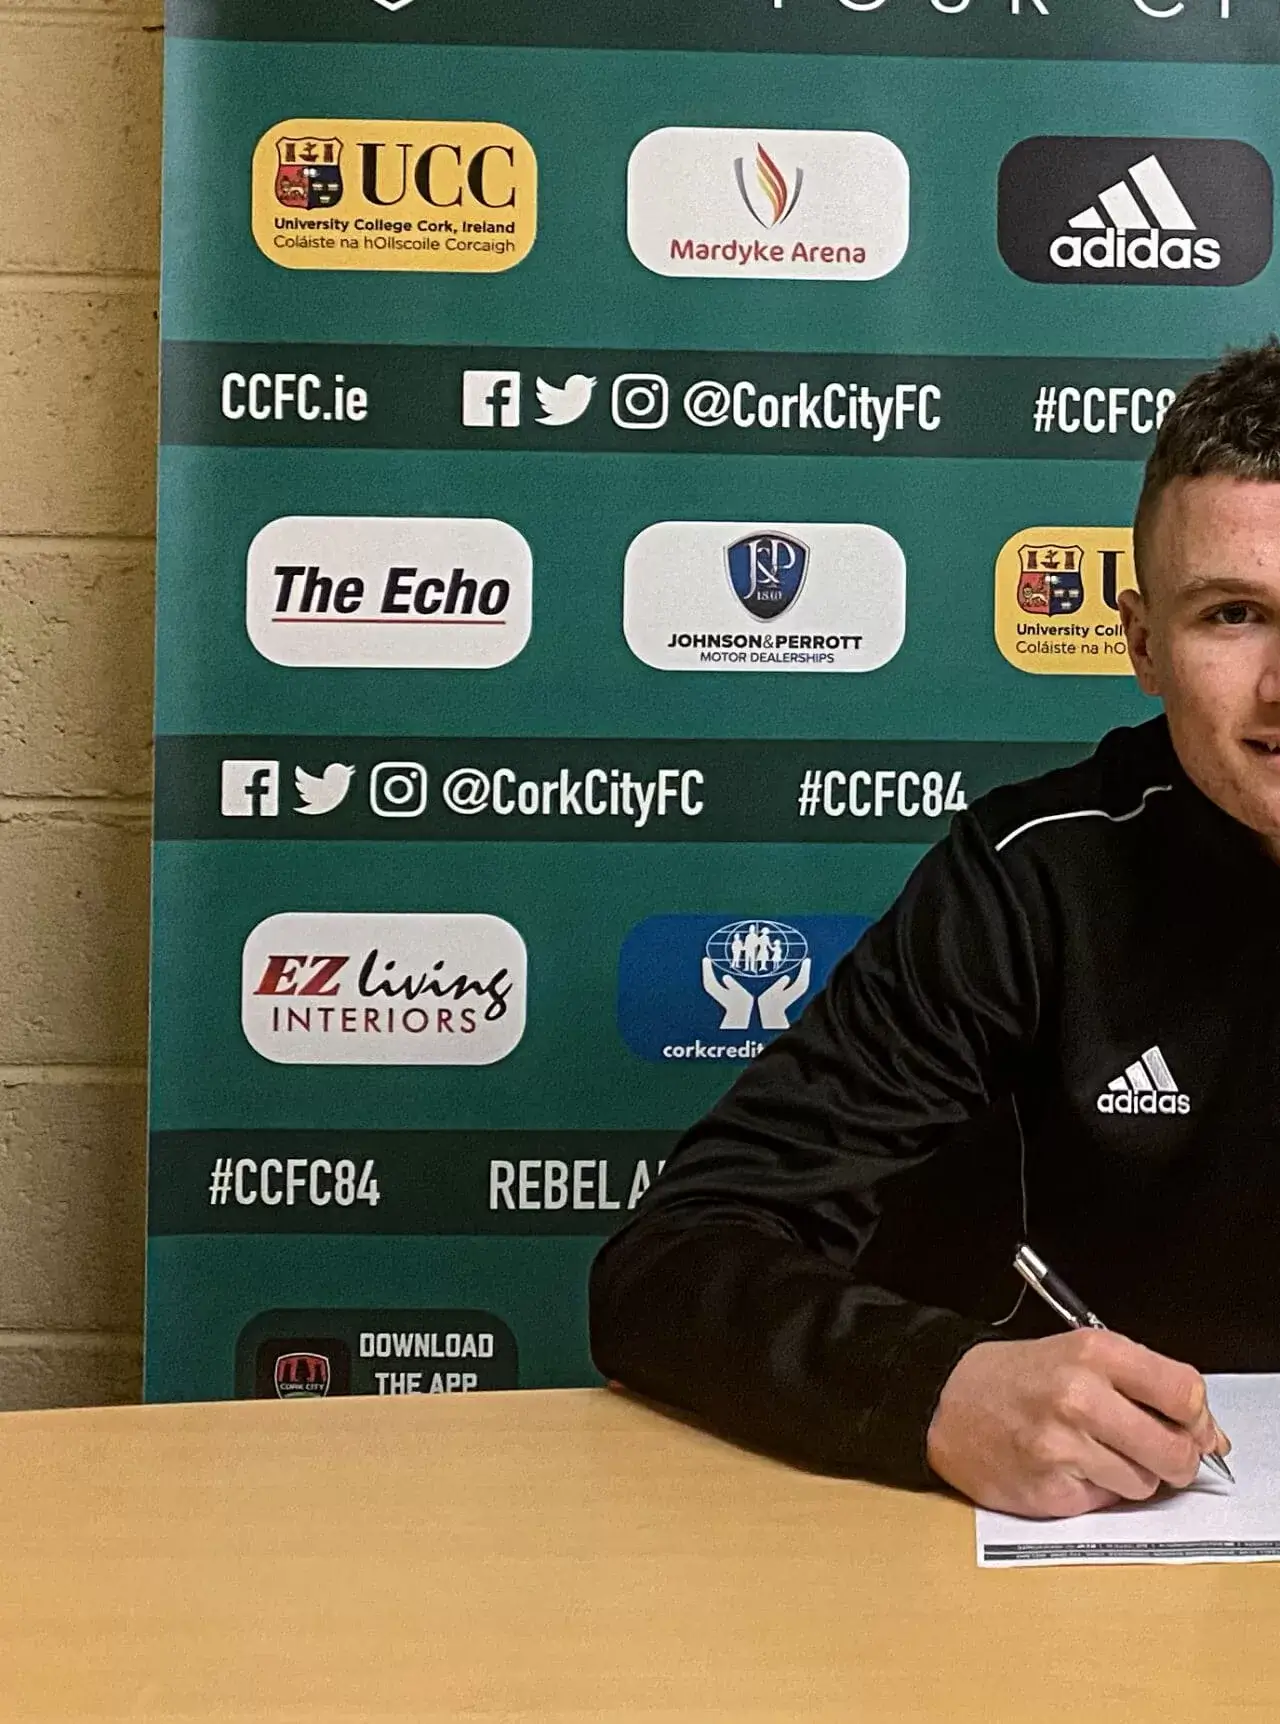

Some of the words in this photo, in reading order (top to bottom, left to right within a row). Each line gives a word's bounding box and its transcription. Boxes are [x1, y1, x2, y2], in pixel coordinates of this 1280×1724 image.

[355, 142, 516, 209] UCC
[274, 217, 350, 233] University
[354, 218, 413, 234] College
[417, 219, 458, 235] Cork,
[462, 220, 516, 234] Ireland
[273, 234, 336, 249] Coláiste
[340, 238, 359, 249] na
[363, 235, 441, 251] hOllscoile
[444, 237, 515, 255] Corcaigh
[670, 239, 784, 266] Mardyke
[791, 242, 866, 264] Arena
[1050, 227, 1221, 270] adidas
[222, 372, 368, 421] CCFC.ie
[1033, 386, 1176, 434] #CCFC8
[683, 380, 941, 442] @CorkCityFC
[272, 565, 364, 614] The
[381, 567, 511, 616] Echo
[667, 633, 863, 650] JOHNSON&PERROTT
[1016, 622, 1090, 639] University
[1095, 624, 1124, 636] Coll
[700, 651, 746, 663] MOTOR
[750, 652, 835, 664] DEALERSHIPS
[1015, 640, 1077, 655] Coláiste
[1080, 644, 1099, 655] na
[442, 767, 704, 828] @CorkCityFC
[798, 770, 968, 817] #CCFC84
[252, 955, 350, 997] EZ
[357, 948, 513, 1020] living
[272, 1006, 476, 1033] INTERIORS
[662, 1039, 764, 1058] corkcredit
[1097, 1089, 1191, 1114] adidas
[208, 1158, 381, 1206] #CCFC84
[489, 1159, 620, 1210] REBEL
[359, 1332, 494, 1358] DOWNLOAD
[374, 1372, 422, 1395] THE
[430, 1372, 478, 1394] APP
